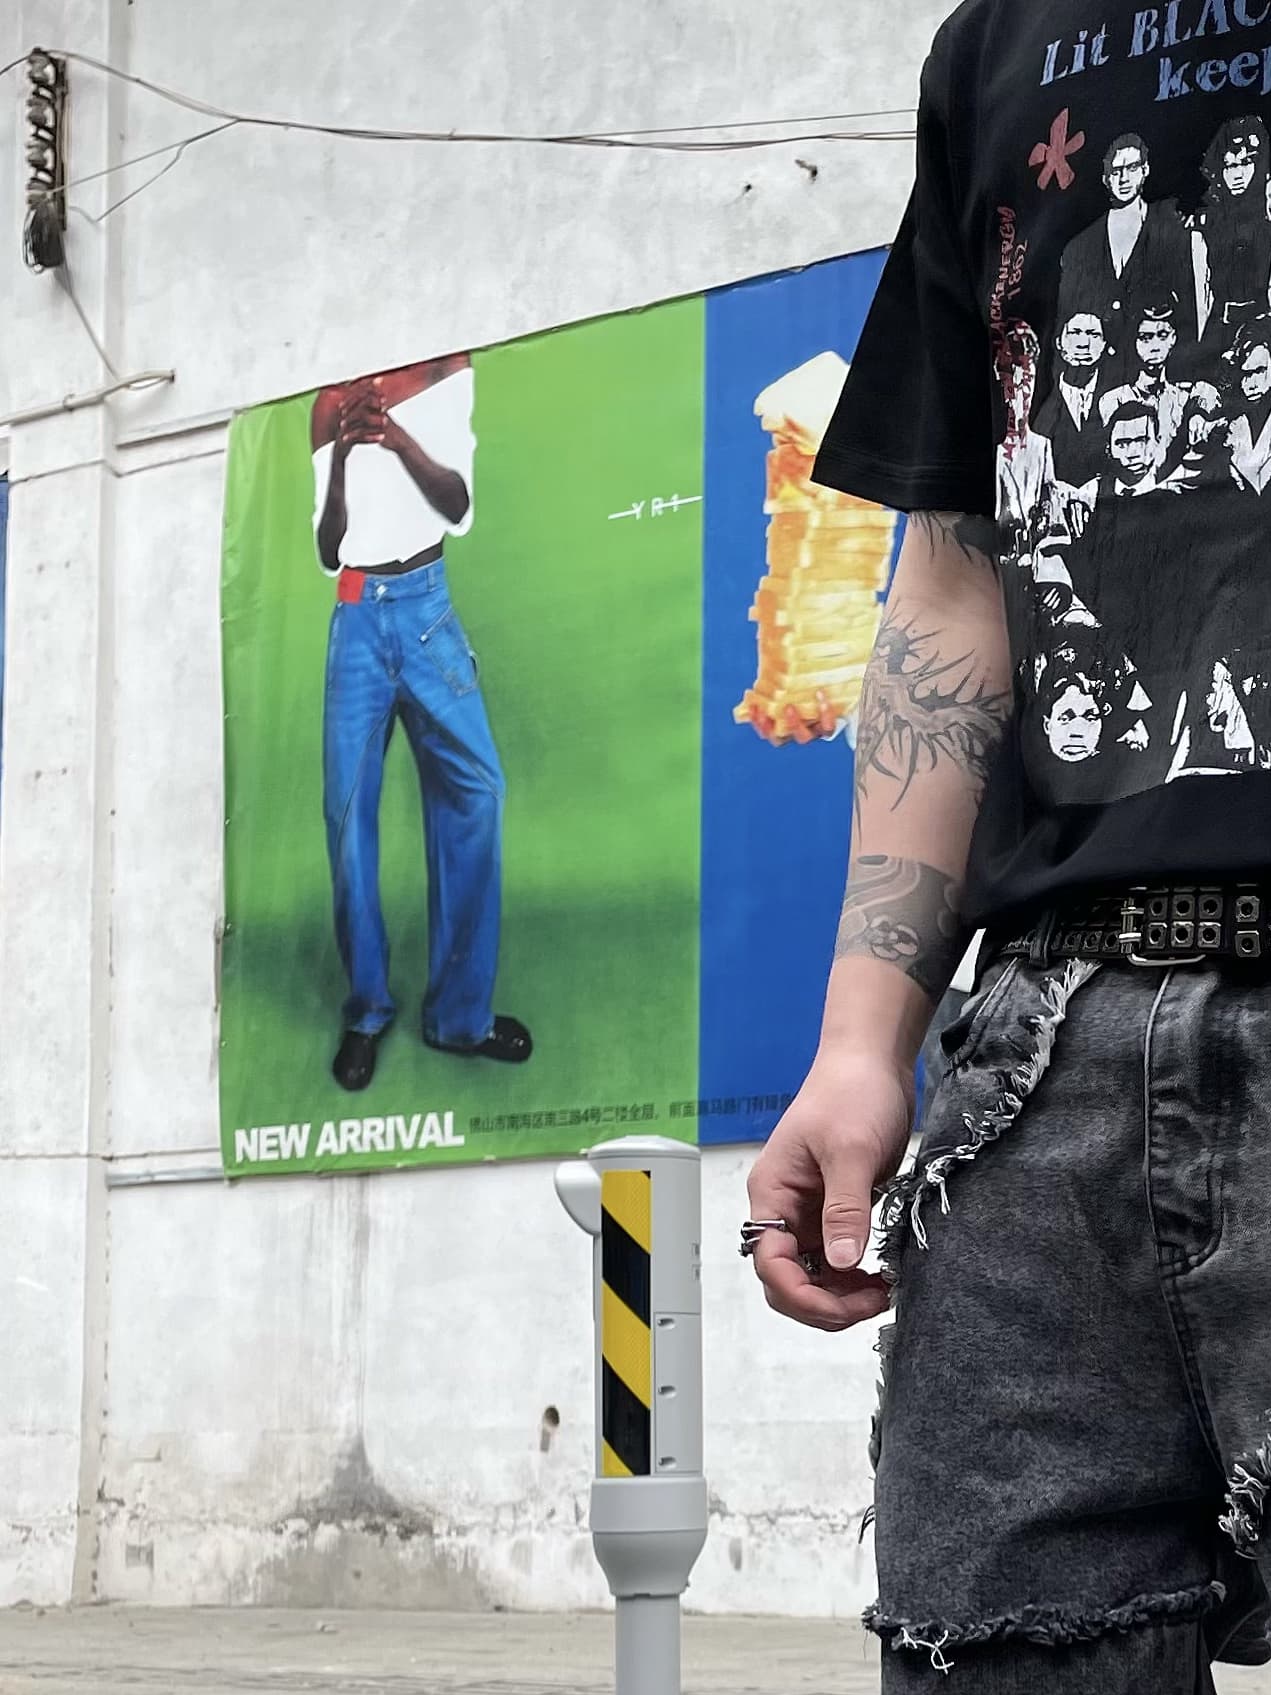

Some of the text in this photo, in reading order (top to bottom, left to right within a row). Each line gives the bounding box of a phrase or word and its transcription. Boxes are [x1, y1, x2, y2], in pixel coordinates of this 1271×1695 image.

[1039, 24, 1111, 86] Lit
[234, 1111, 465, 1163] NEW ARRIVAL
